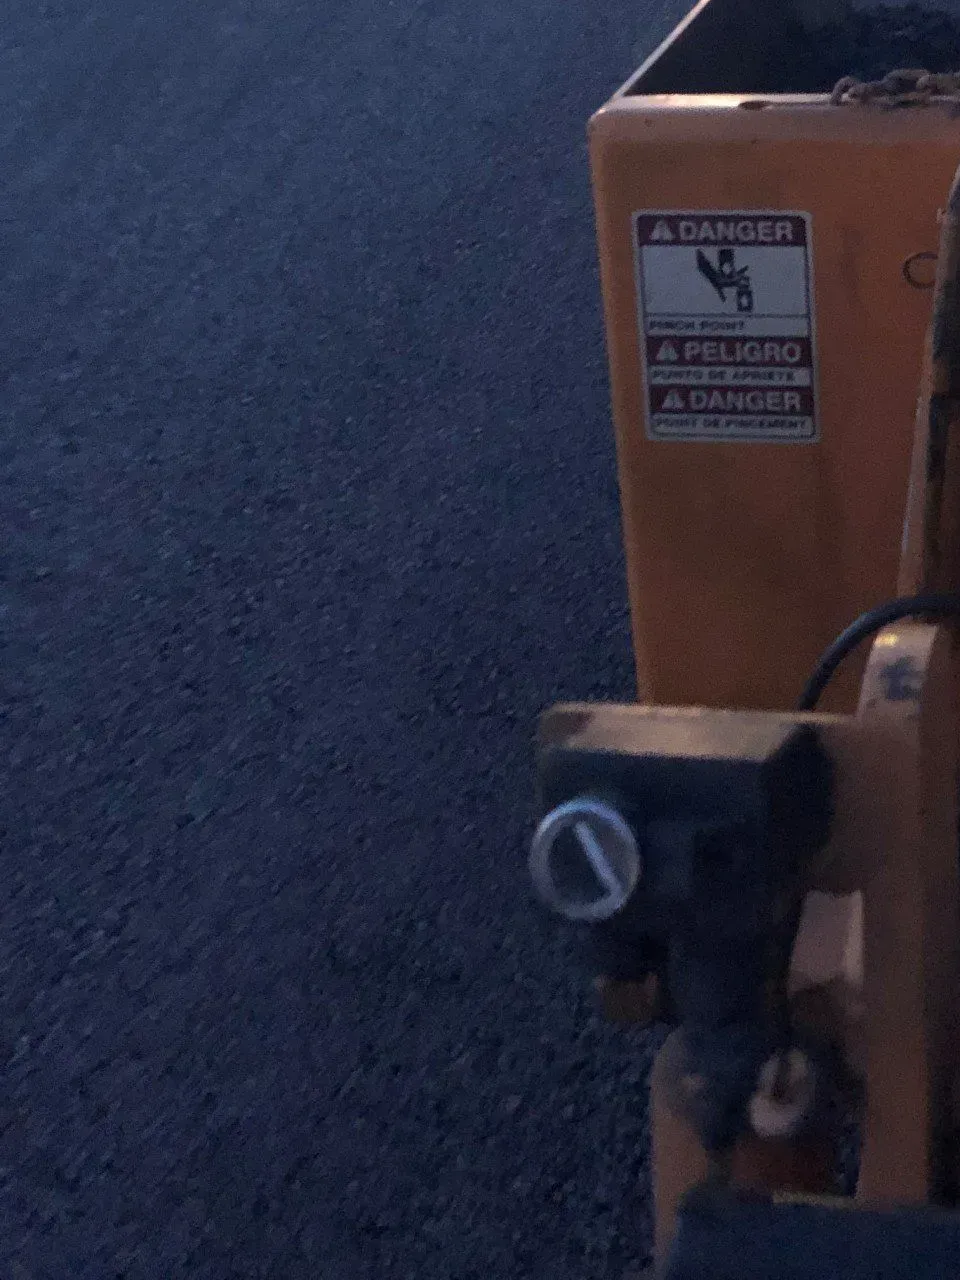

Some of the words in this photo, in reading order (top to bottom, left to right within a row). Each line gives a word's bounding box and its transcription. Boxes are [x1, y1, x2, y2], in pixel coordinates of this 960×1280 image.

[679, 221, 793, 241] DANGER
[684, 342, 802, 363] PELIGRO
[689, 390, 801, 410] DANGER
